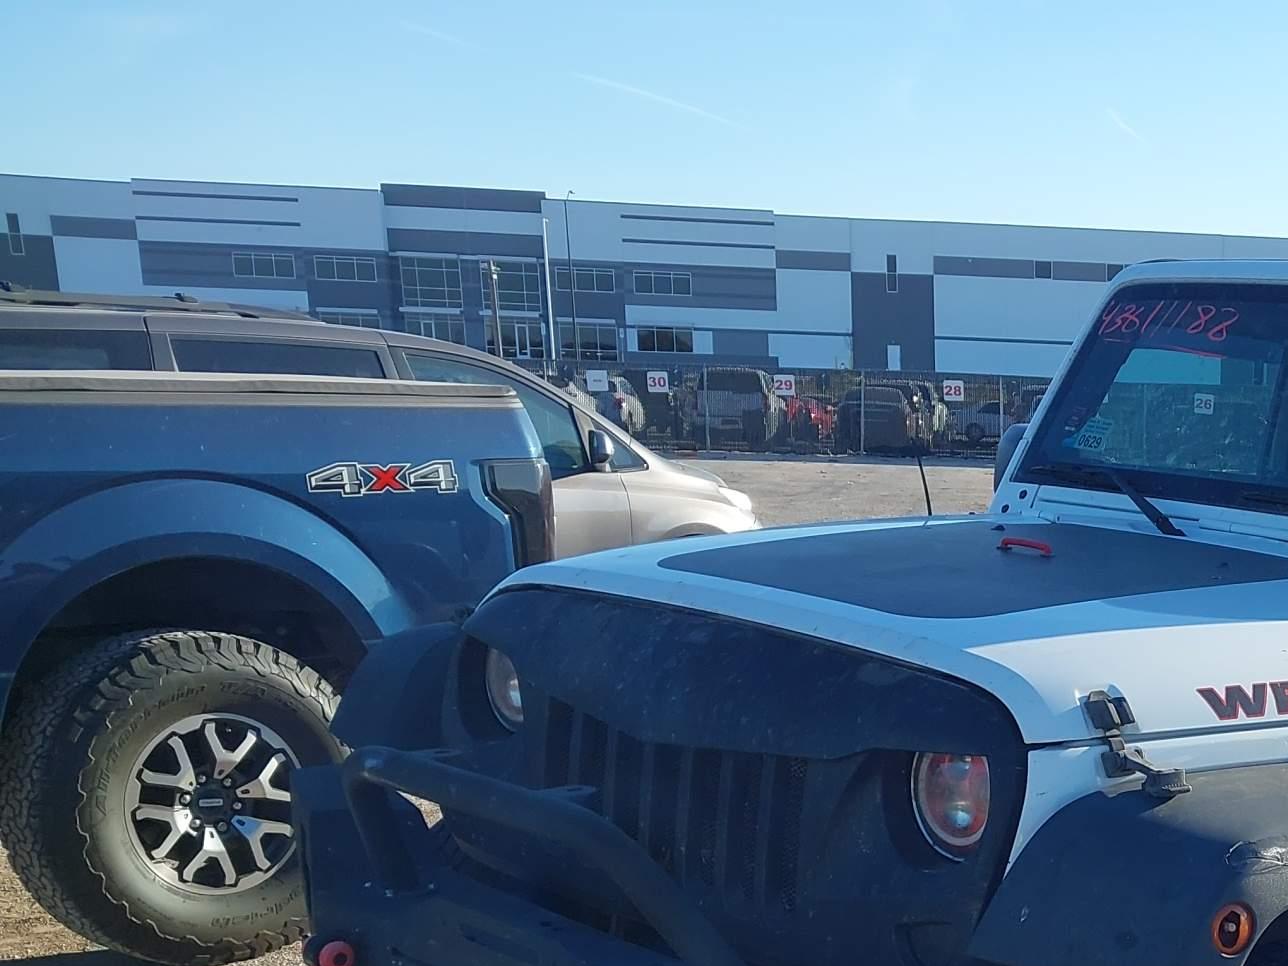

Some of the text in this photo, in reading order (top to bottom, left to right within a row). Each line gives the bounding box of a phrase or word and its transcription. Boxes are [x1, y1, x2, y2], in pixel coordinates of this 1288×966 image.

[647, 376, 667, 388] 30
[774, 379, 794, 391] 29
[944, 384, 962, 397] 28
[1195, 398, 1213, 411] 26
[1077, 433, 1103, 450] 0629
